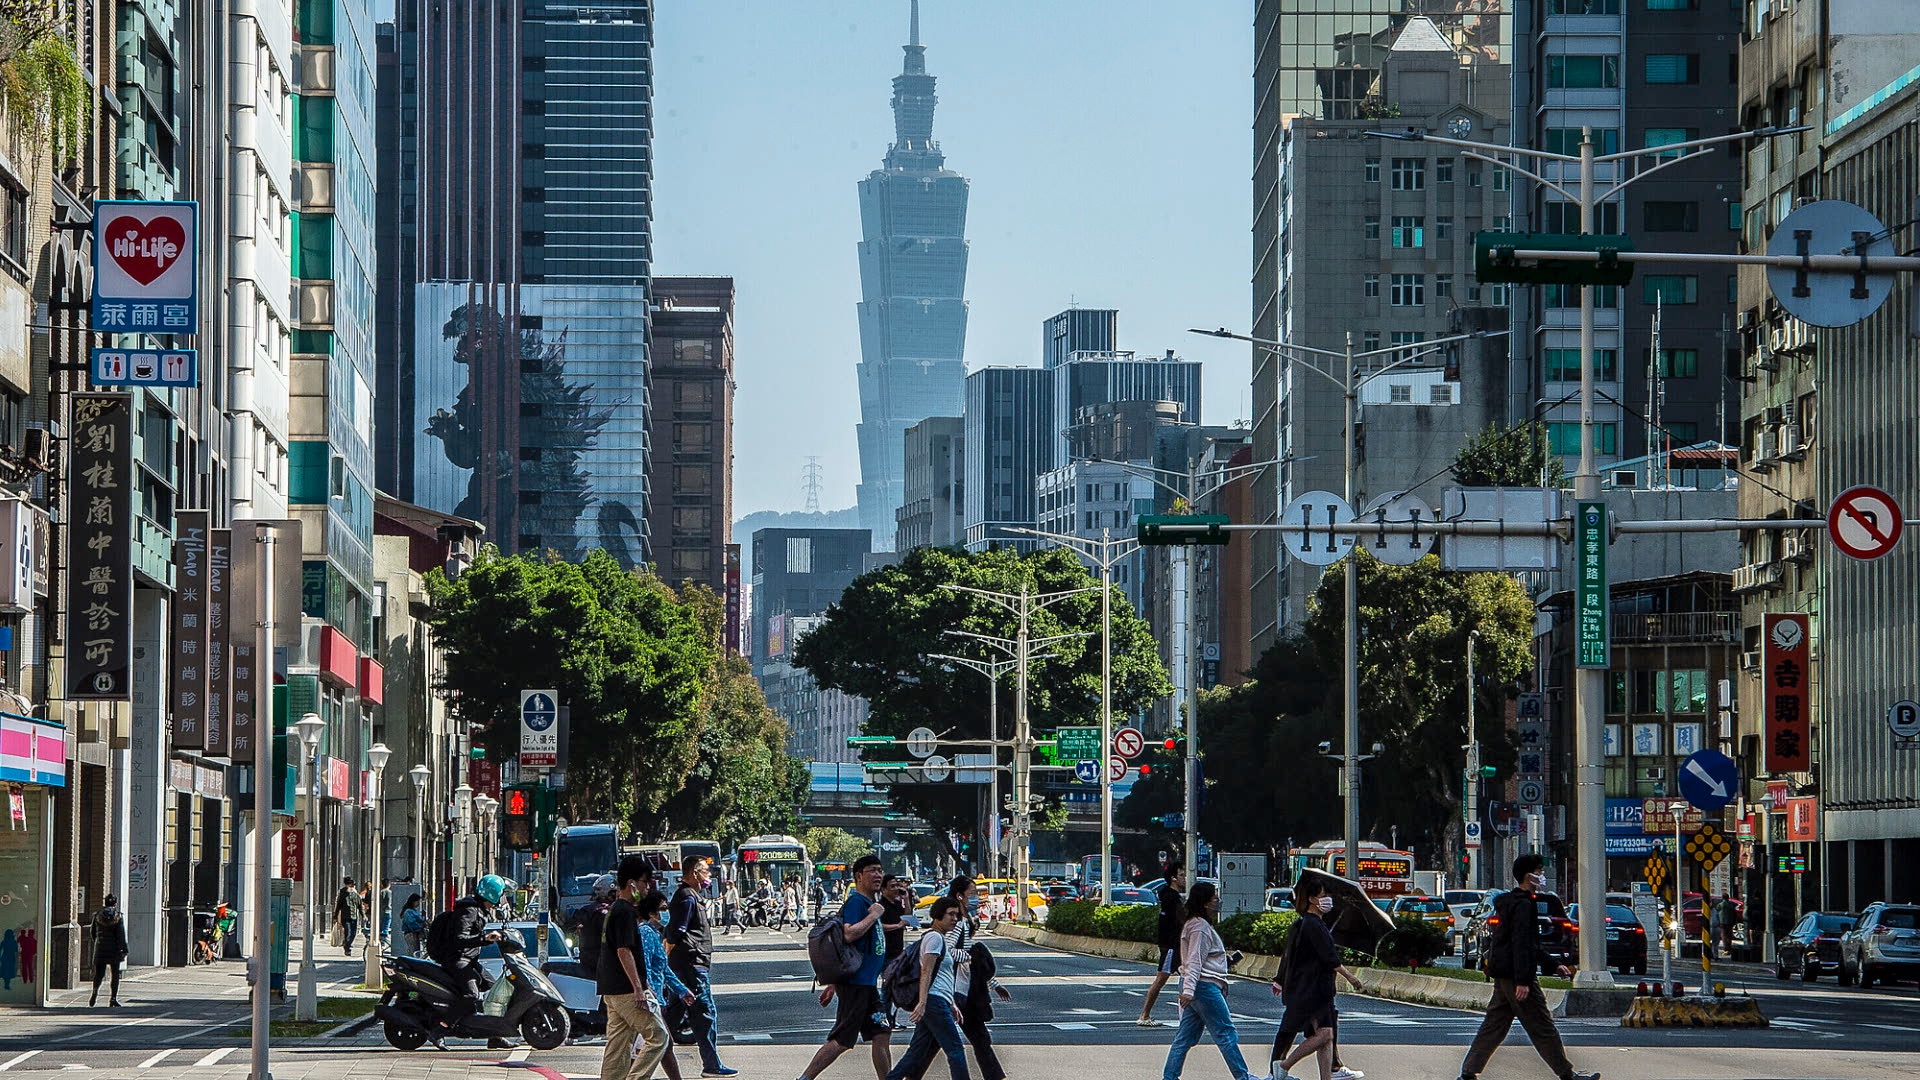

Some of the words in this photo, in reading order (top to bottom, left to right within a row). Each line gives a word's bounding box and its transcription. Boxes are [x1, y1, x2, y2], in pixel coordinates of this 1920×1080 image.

[113, 231, 178, 268] Hi-Life
[100, 304, 189, 327] 萊爾富
[81, 422, 120, 668] 劉桂蘭中醫診所
[177, 526, 205, 578] Milano
[1586, 528, 1599, 607] 忠孝東路一段
[211, 545, 229, 592] Milano
[1583, 607, 1602, 617] Zhong
[181, 587, 198, 733] 米蘭時尚診所
[1774, 659, 1800, 759] 吉野家
[522, 735, 556, 745] 行人優先
[1613, 806, 1642, 822] H25
[286, 832, 299, 878] 台中銀行
